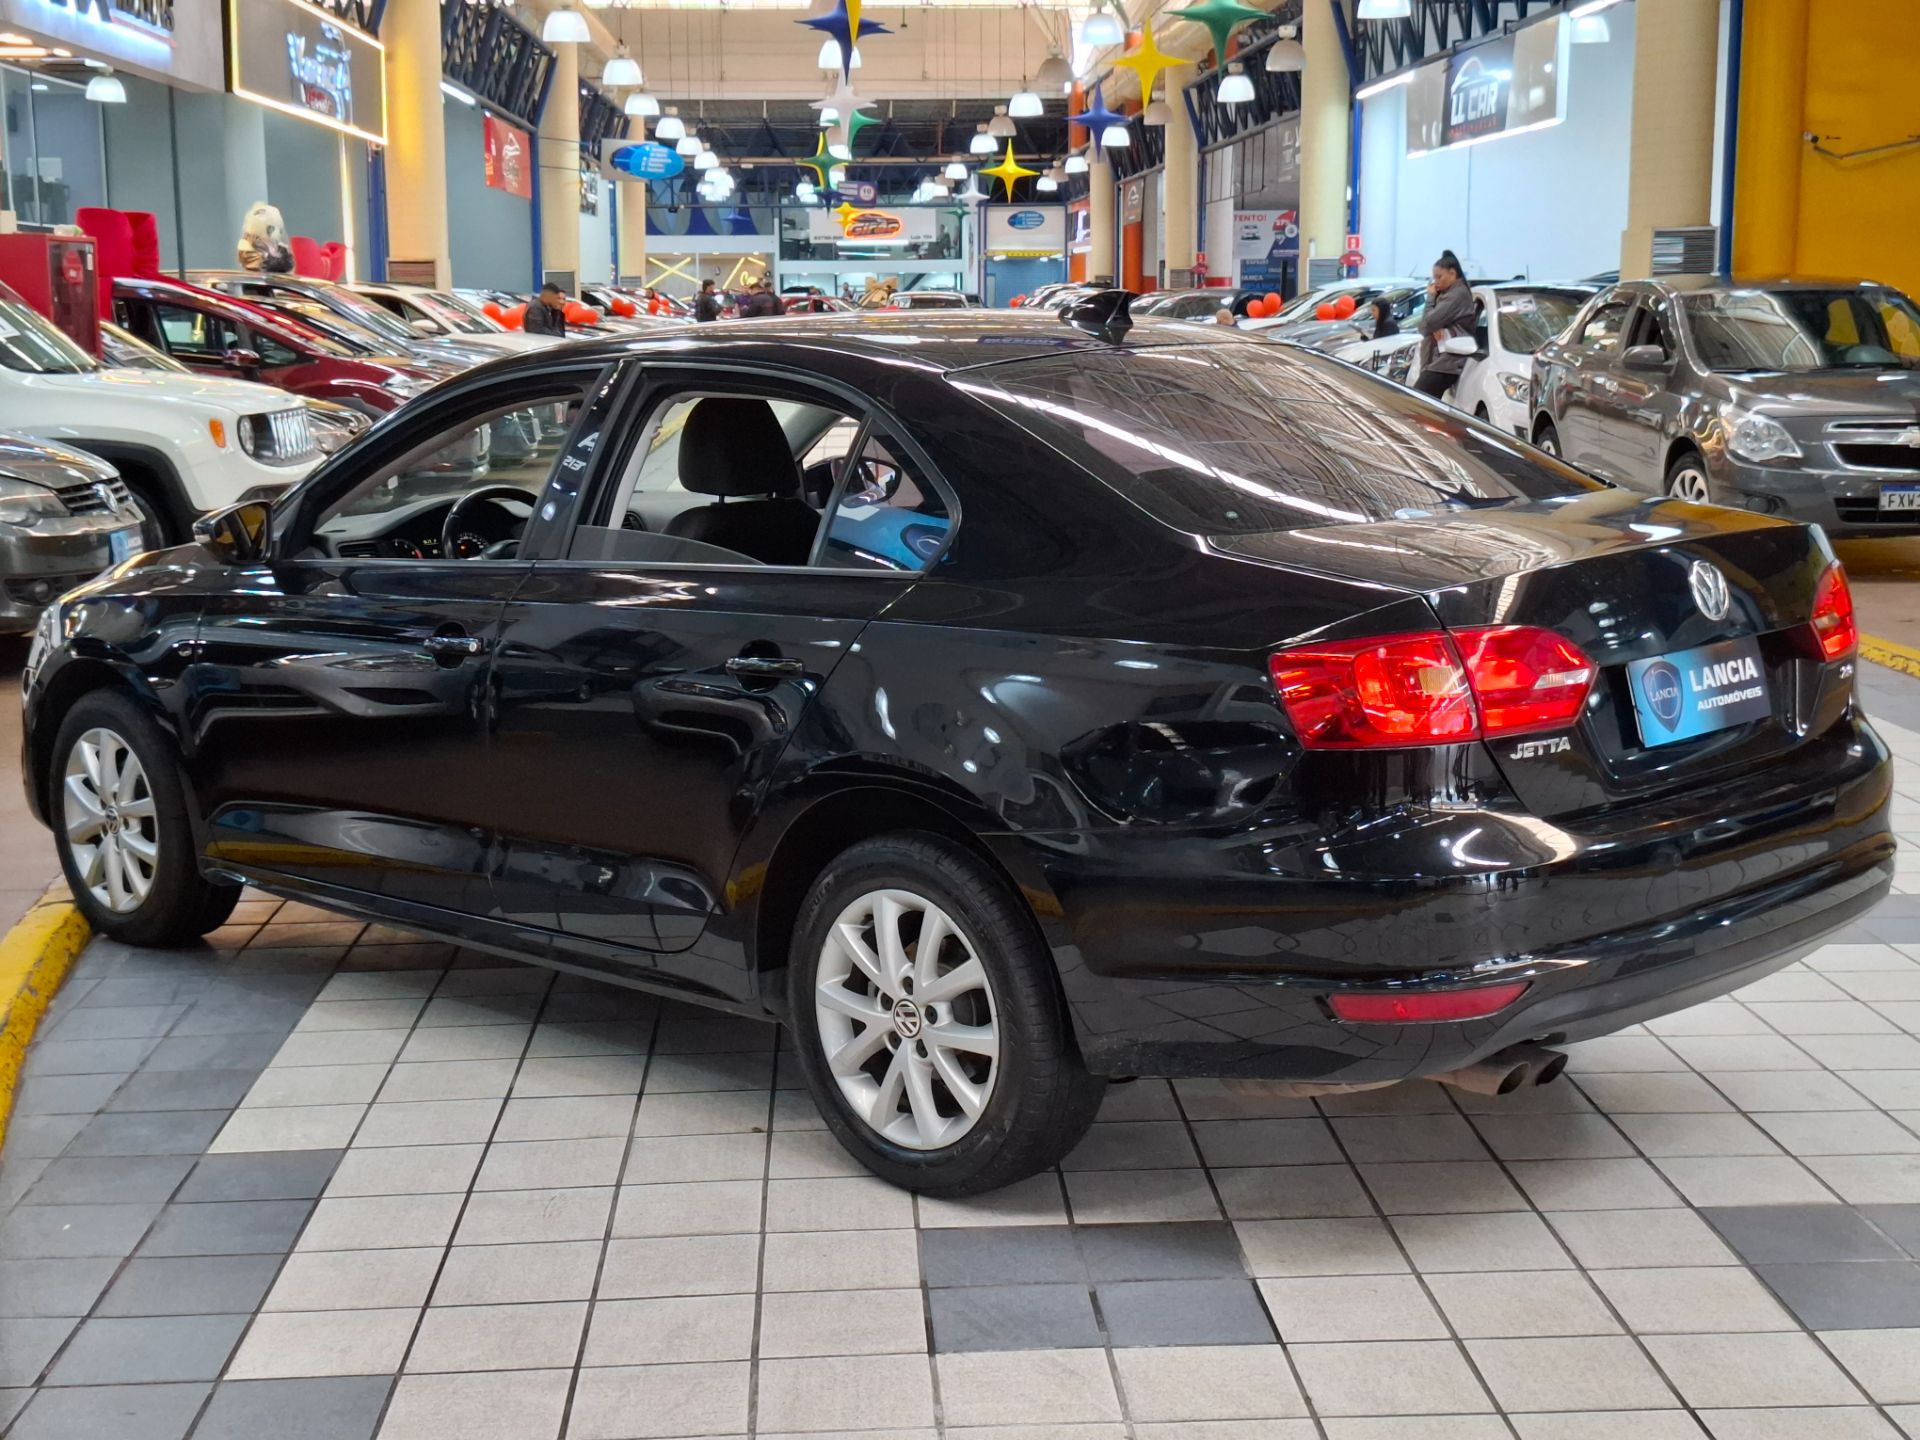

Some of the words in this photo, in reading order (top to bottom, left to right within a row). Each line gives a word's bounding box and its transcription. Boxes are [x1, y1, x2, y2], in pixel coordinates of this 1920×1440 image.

[1466, 80, 1499, 121] CAR
[1688, 656, 1760, 693] LANCIA
[1696, 686, 1763, 712] AUTOMÓVEIS
[1509, 736, 1571, 760] JETTA
